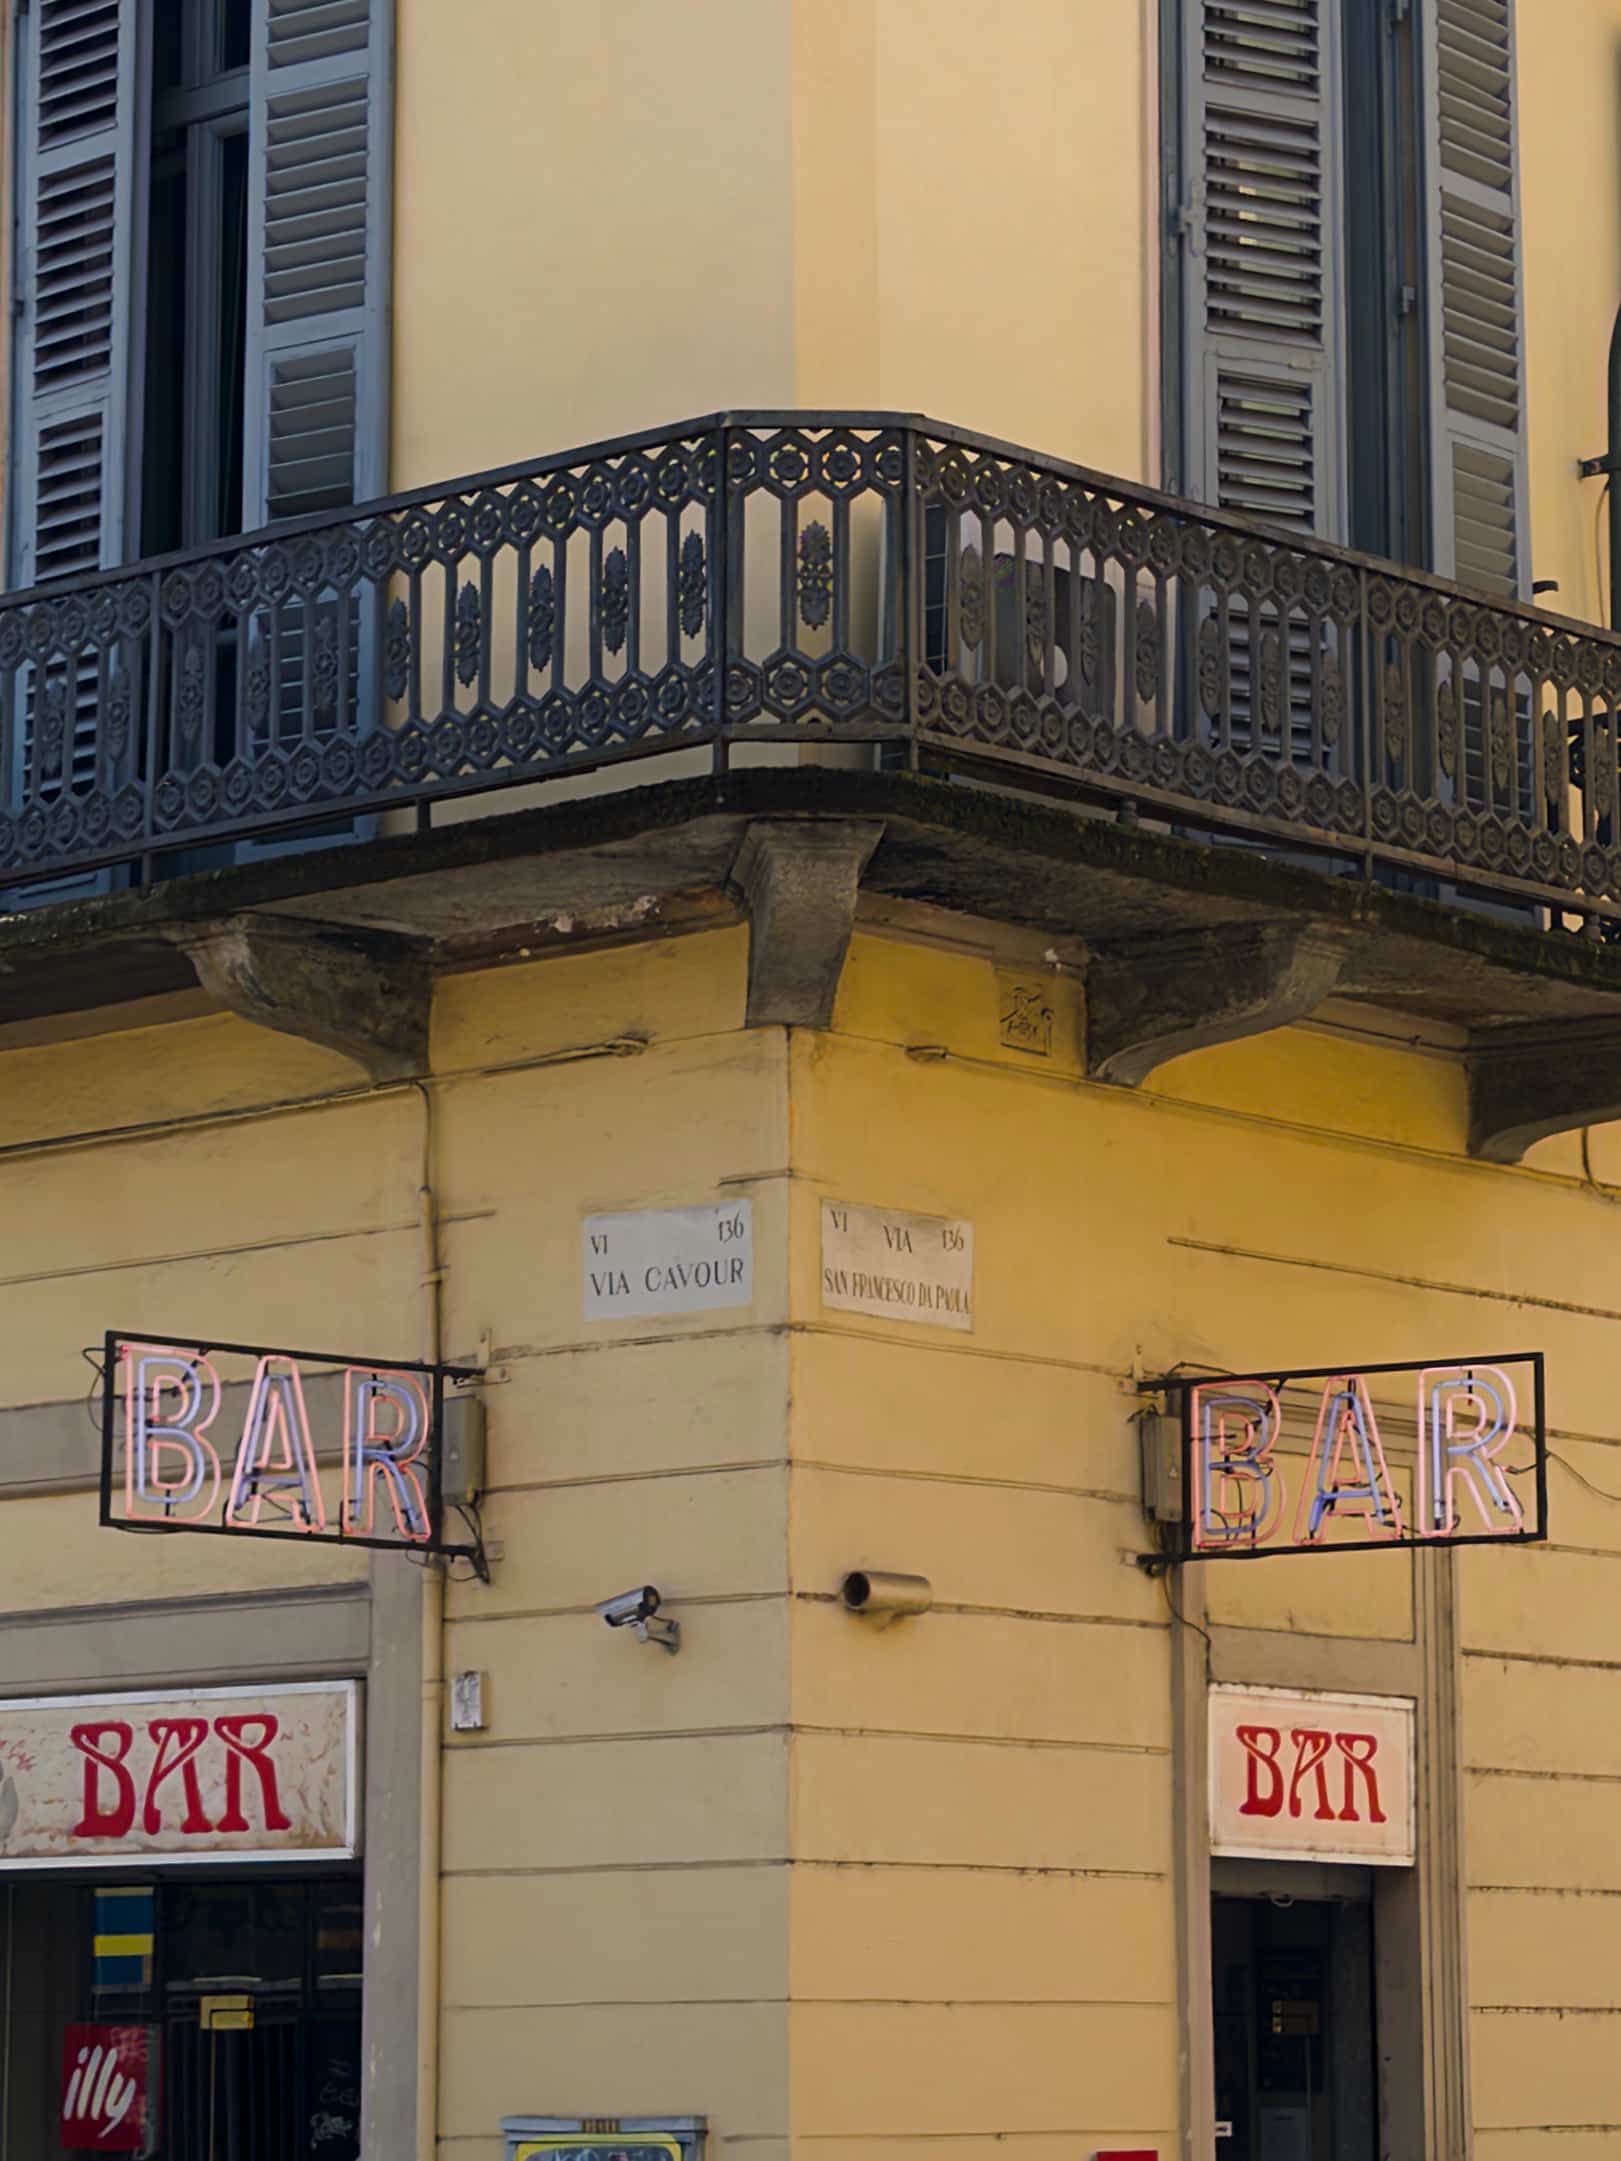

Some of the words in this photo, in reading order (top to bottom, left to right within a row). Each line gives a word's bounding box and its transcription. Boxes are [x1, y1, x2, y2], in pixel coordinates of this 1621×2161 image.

[717, 1212, 745, 1243] 136
[830, 1208, 848, 1233] VI
[883, 1225, 913, 1254] VIA
[942, 1225, 965, 1253] 136
[590, 1233, 608, 1256] VI
[590, 1271, 631, 1297] VIA
[644, 1257, 745, 1293] CAVOUR
[824, 1267, 849, 1296] SAN
[852, 1271, 916, 1306] FRANCESCO
[121, 1344, 432, 1542] BAR
[1191, 1364, 1524, 1550] BAR
[70, 1714, 292, 1838] BAR
[1235, 1724, 1387, 1823] BAR
[63, 2045, 137, 2139] illy
